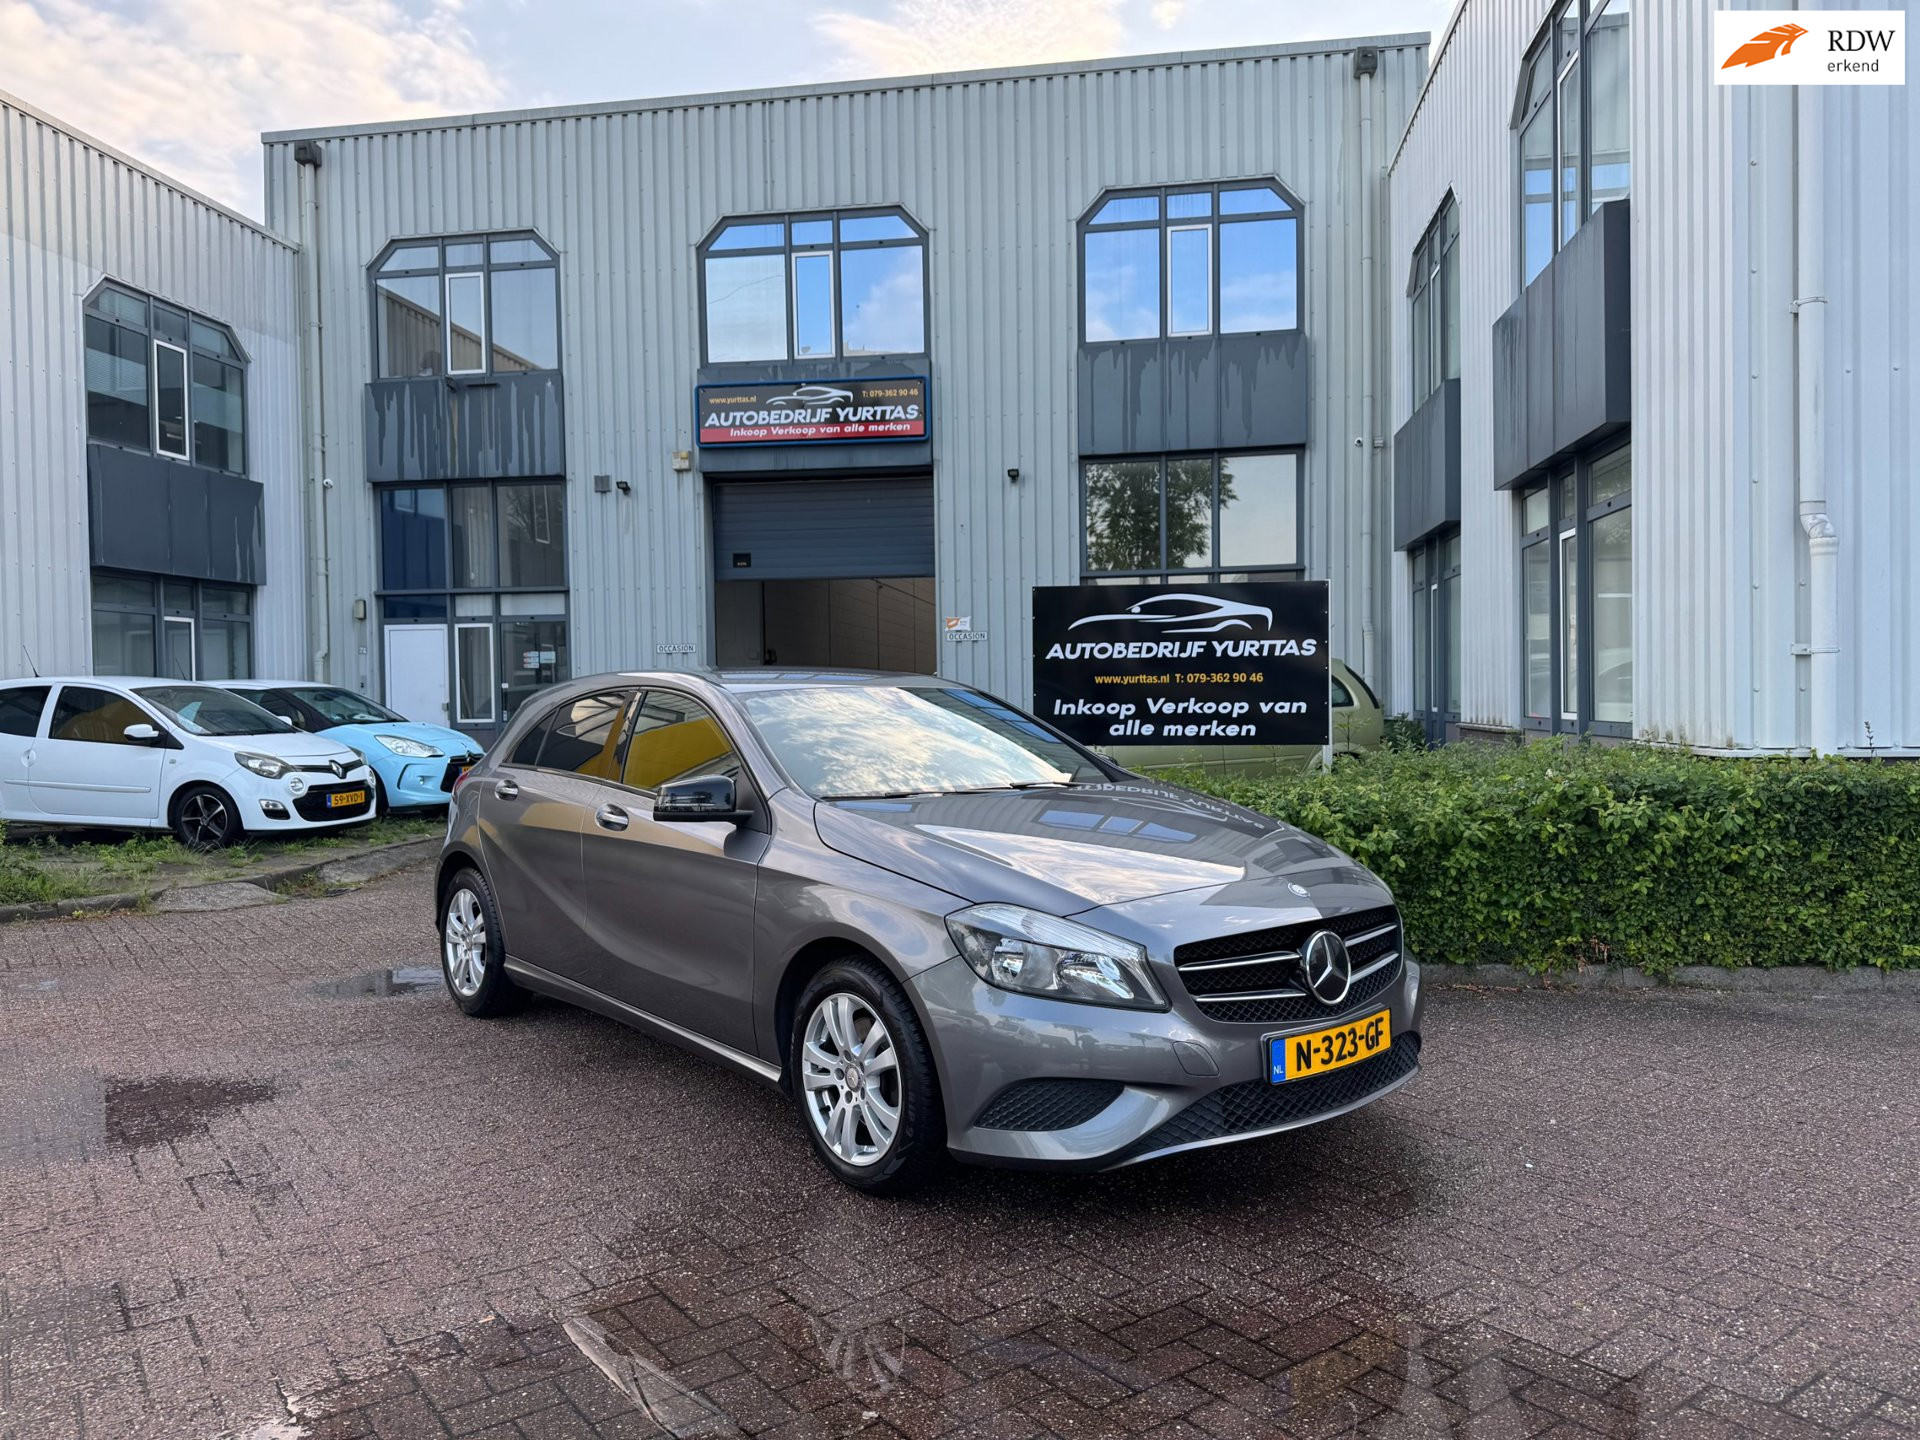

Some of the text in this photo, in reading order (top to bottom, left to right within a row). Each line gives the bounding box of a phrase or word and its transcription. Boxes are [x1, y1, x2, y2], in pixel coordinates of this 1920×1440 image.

[709, 395, 757, 404] www.yurttas.nl
[869, 389, 897, 397] 079-362
[898, 388, 908, 396] 90
[909, 388, 919, 396] 46
[705, 404, 919, 427] AUTOBEDRIJF YURTTAS
[730, 427, 768, 437] Inkoop
[771, 425, 816, 436] Verkoop
[844, 424, 865, 432] alle
[868, 422, 911, 431] merken
[947, 632, 985, 640] OCCASION
[658, 644, 694, 652] OCCASION
[1045, 638, 1317, 659] AUTOBEDRIJF YURTTAS
[1094, 672, 1264, 685] www.yurttas.nl T: 079-362 90 46
[1053, 697, 1307, 719] Inkoop Verkoop van
[1109, 719, 1257, 737] alle merken
[334, 791, 363, 805] 59-XVD-1
[1296, 1017, 1384, 1072] N-323-GF
[1273, 1065, 1284, 1075] NL
